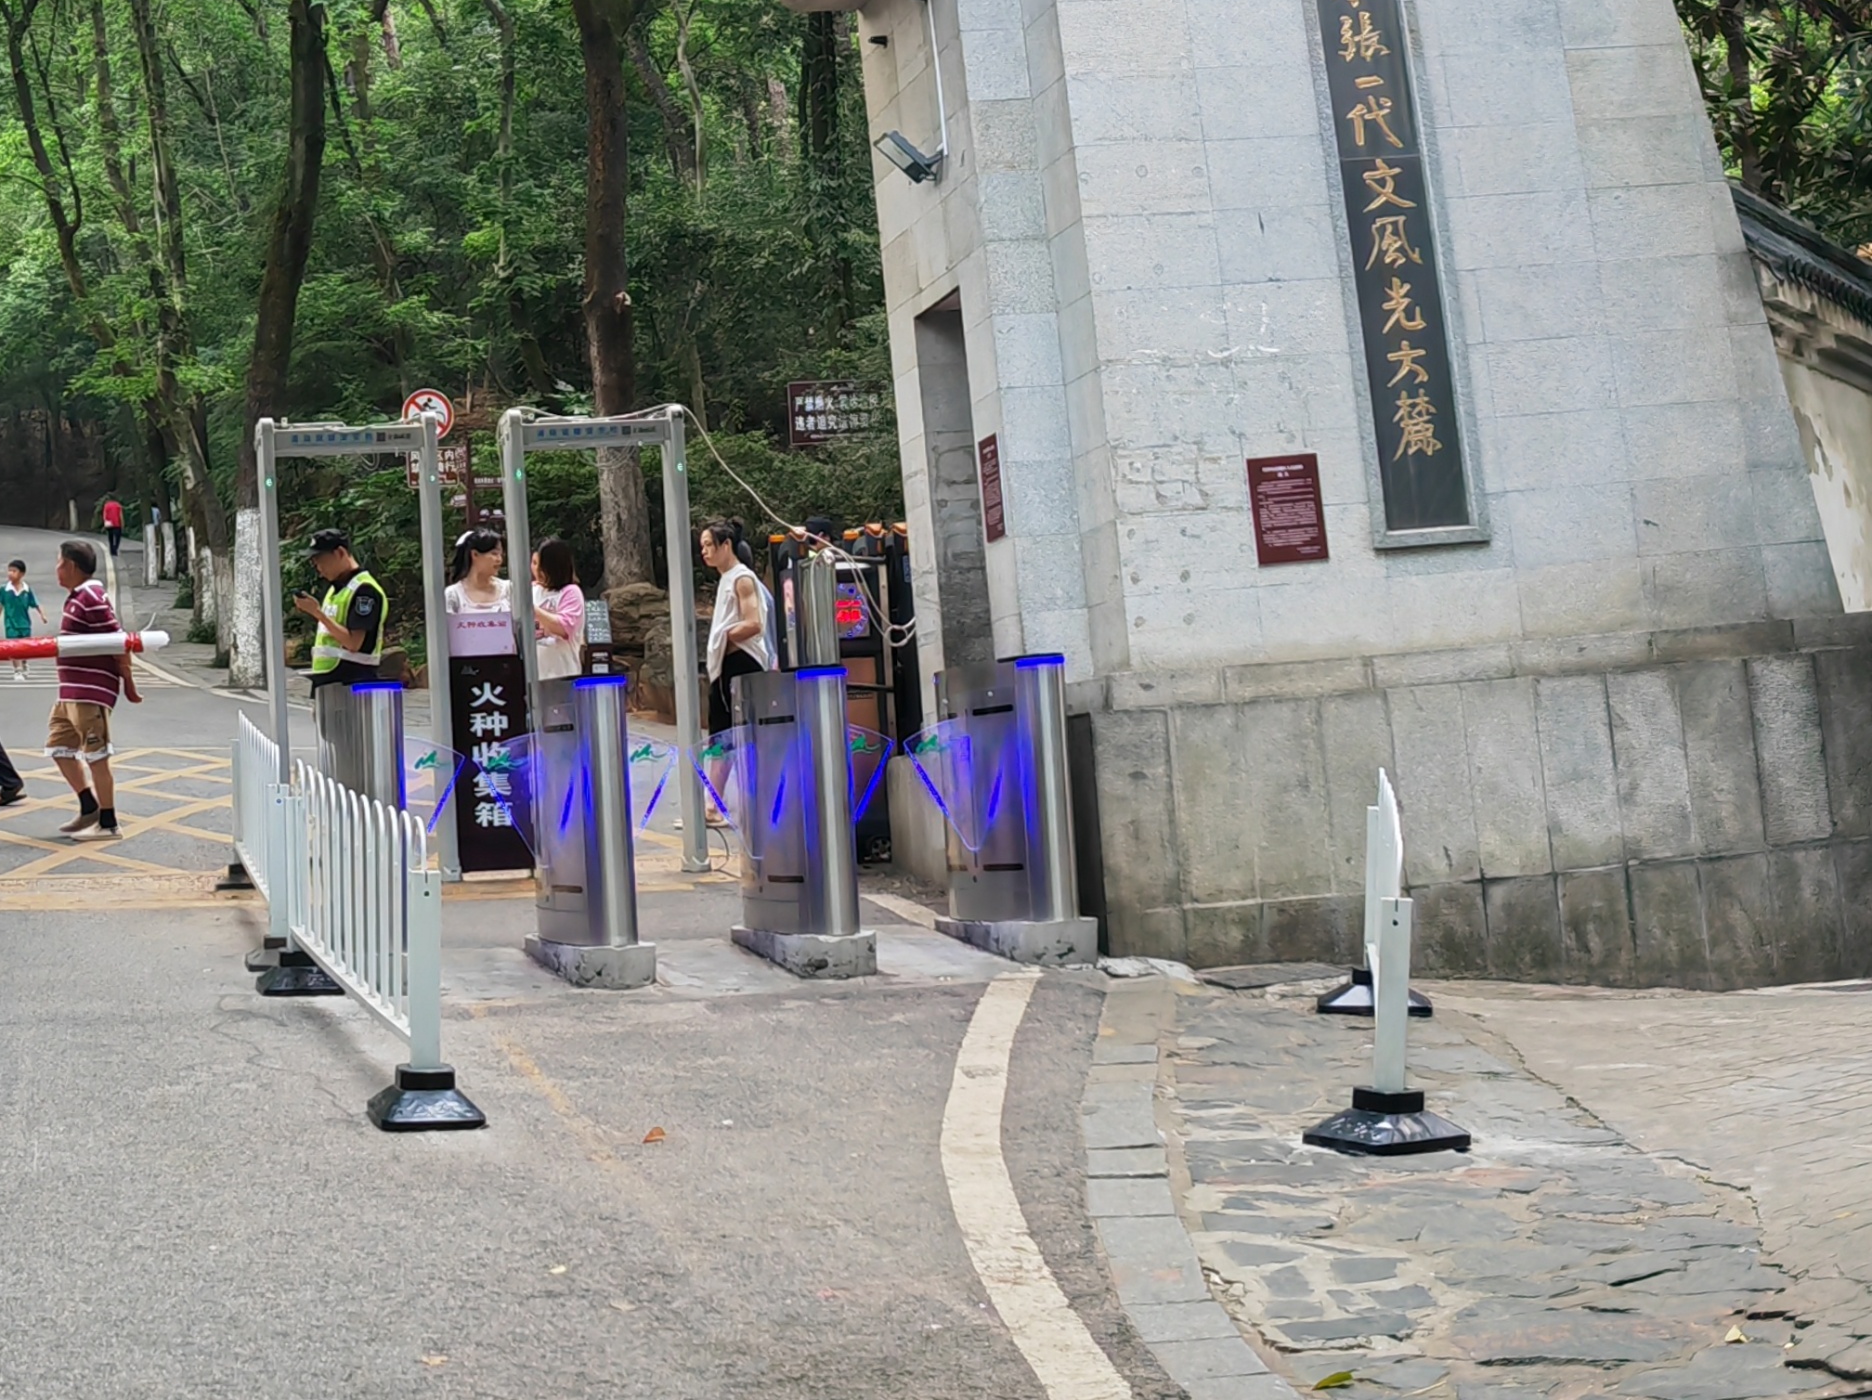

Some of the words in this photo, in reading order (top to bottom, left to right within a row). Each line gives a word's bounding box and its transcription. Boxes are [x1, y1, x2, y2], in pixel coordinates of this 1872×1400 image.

[470, 682, 512, 827] 火种收集箱
